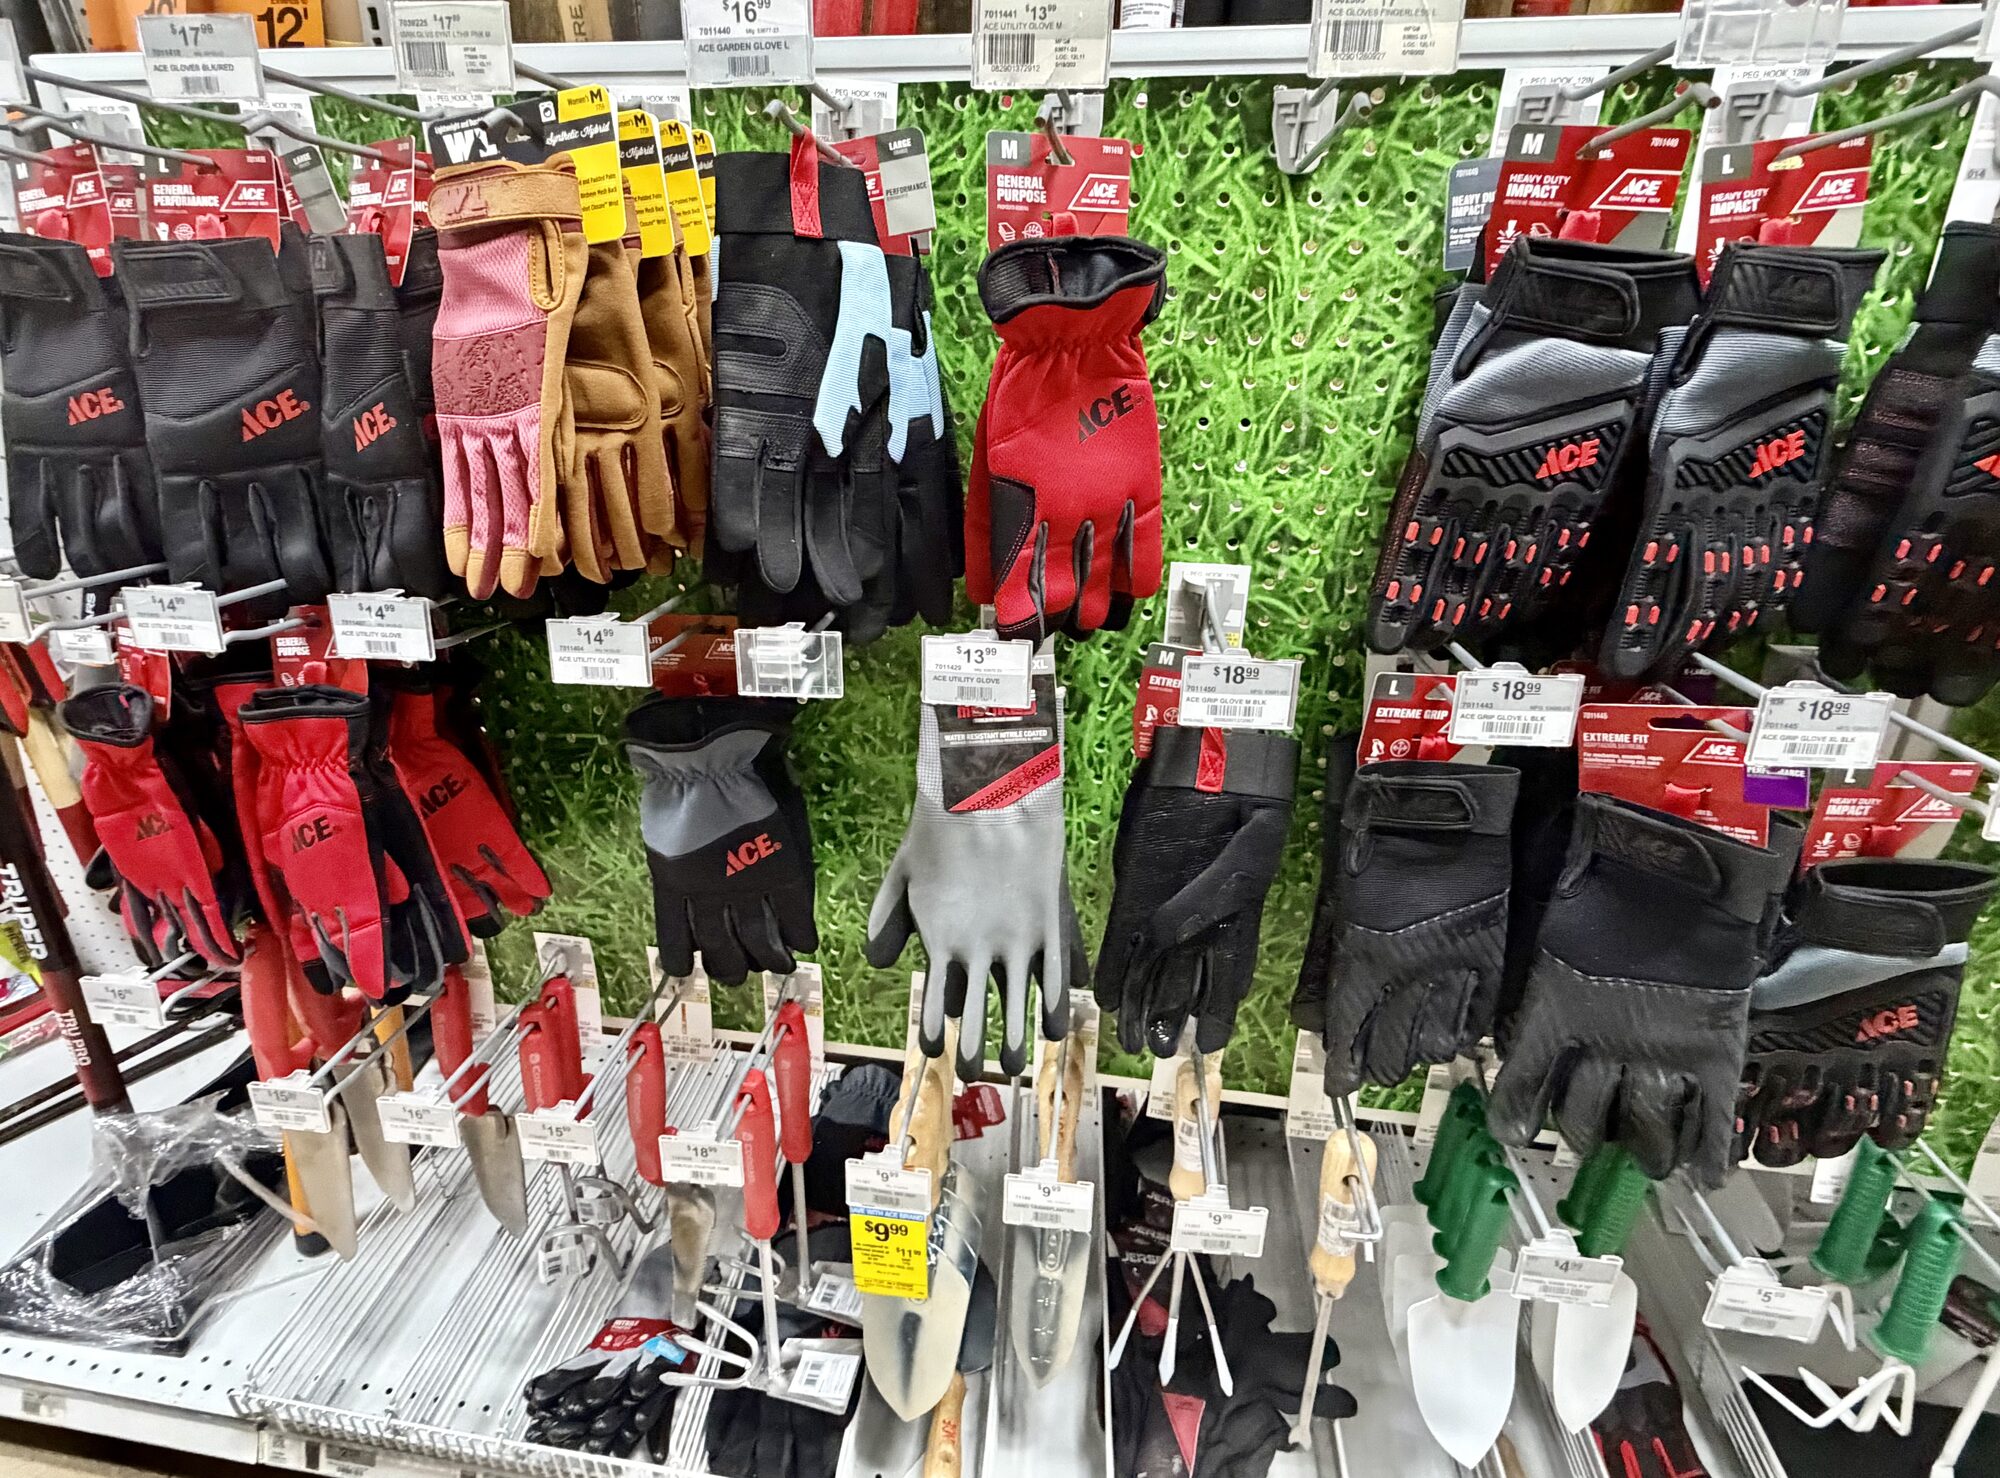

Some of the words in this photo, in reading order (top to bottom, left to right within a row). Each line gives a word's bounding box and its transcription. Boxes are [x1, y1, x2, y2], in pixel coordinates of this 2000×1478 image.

[699, 27, 731, 35] 7011440
[984, 22, 998, 30] ACE
[1001, 22, 1027, 30] UTILITY
[1029, 22, 1054, 30] GLOVE
[698, 44, 715, 52] ACE
[717, 43, 752, 51] GARDEN
[753, 41, 782, 50] GLOVE
[590, 88, 603, 103] M
[634, 114, 647, 127] M
[668, 123, 681, 136] M
[888, 138, 912, 151] LARGE
[1001, 139, 1018, 160] M
[1521, 132, 1545, 155] M
[158, 157, 170, 173] L
[1721, 154, 1735, 174] L
[997, 174, 1045, 189] GENERAL
[1509, 174, 1543, 185] HEAVY
[1543, 175, 1571, 186] DUTY
[1620, 177, 1664, 196] ACE
[1816, 178, 1856, 197] ACE
[153, 184, 195, 196] GENERAL
[237, 187, 266, 200] ACE
[886, 182, 928, 196] PERFORMANCE
[997, 187, 1047, 203] PURPOSE
[1088, 181, 1119, 198] ACE
[1506, 184, 1560, 199] IMPACT
[1711, 190, 1742, 202] HEAVY
[1743, 188, 1770, 199] DUTY
[153, 195, 220, 208] PERFORMANCE
[1482, 190, 1497, 204] DU
[1451, 203, 1487, 218] IMPACT
[1709, 198, 1761, 217] IMPACT
[68, 387, 121, 426] ACE
[241, 388, 304, 443] ACE
[1078, 384, 1135, 445] ACE
[354, 402, 394, 453] ACE
[1536, 438, 1600, 479] ACE
[1749, 429, 1806, 478] ACE
[1158, 650, 1176, 666] M
[976, 677, 1001, 685] GLOVE
[1389, 679, 1400, 696] L
[1375, 707, 1422, 719] EXTREME
[1423, 709, 1449, 720] GRIP
[1583, 732, 1631, 743] EXTREME
[1632, 734, 1650, 744] FIT
[1703, 744, 1737, 756] ACE
[418, 773, 466, 820] ACE
[1825, 805, 1873, 816] IMPACT
[292, 814, 335, 855] ACE
[726, 833, 775, 877] ACE
[0, 863, 49, 960] TRUPER
[1855, 1004, 1919, 1042] ACE
